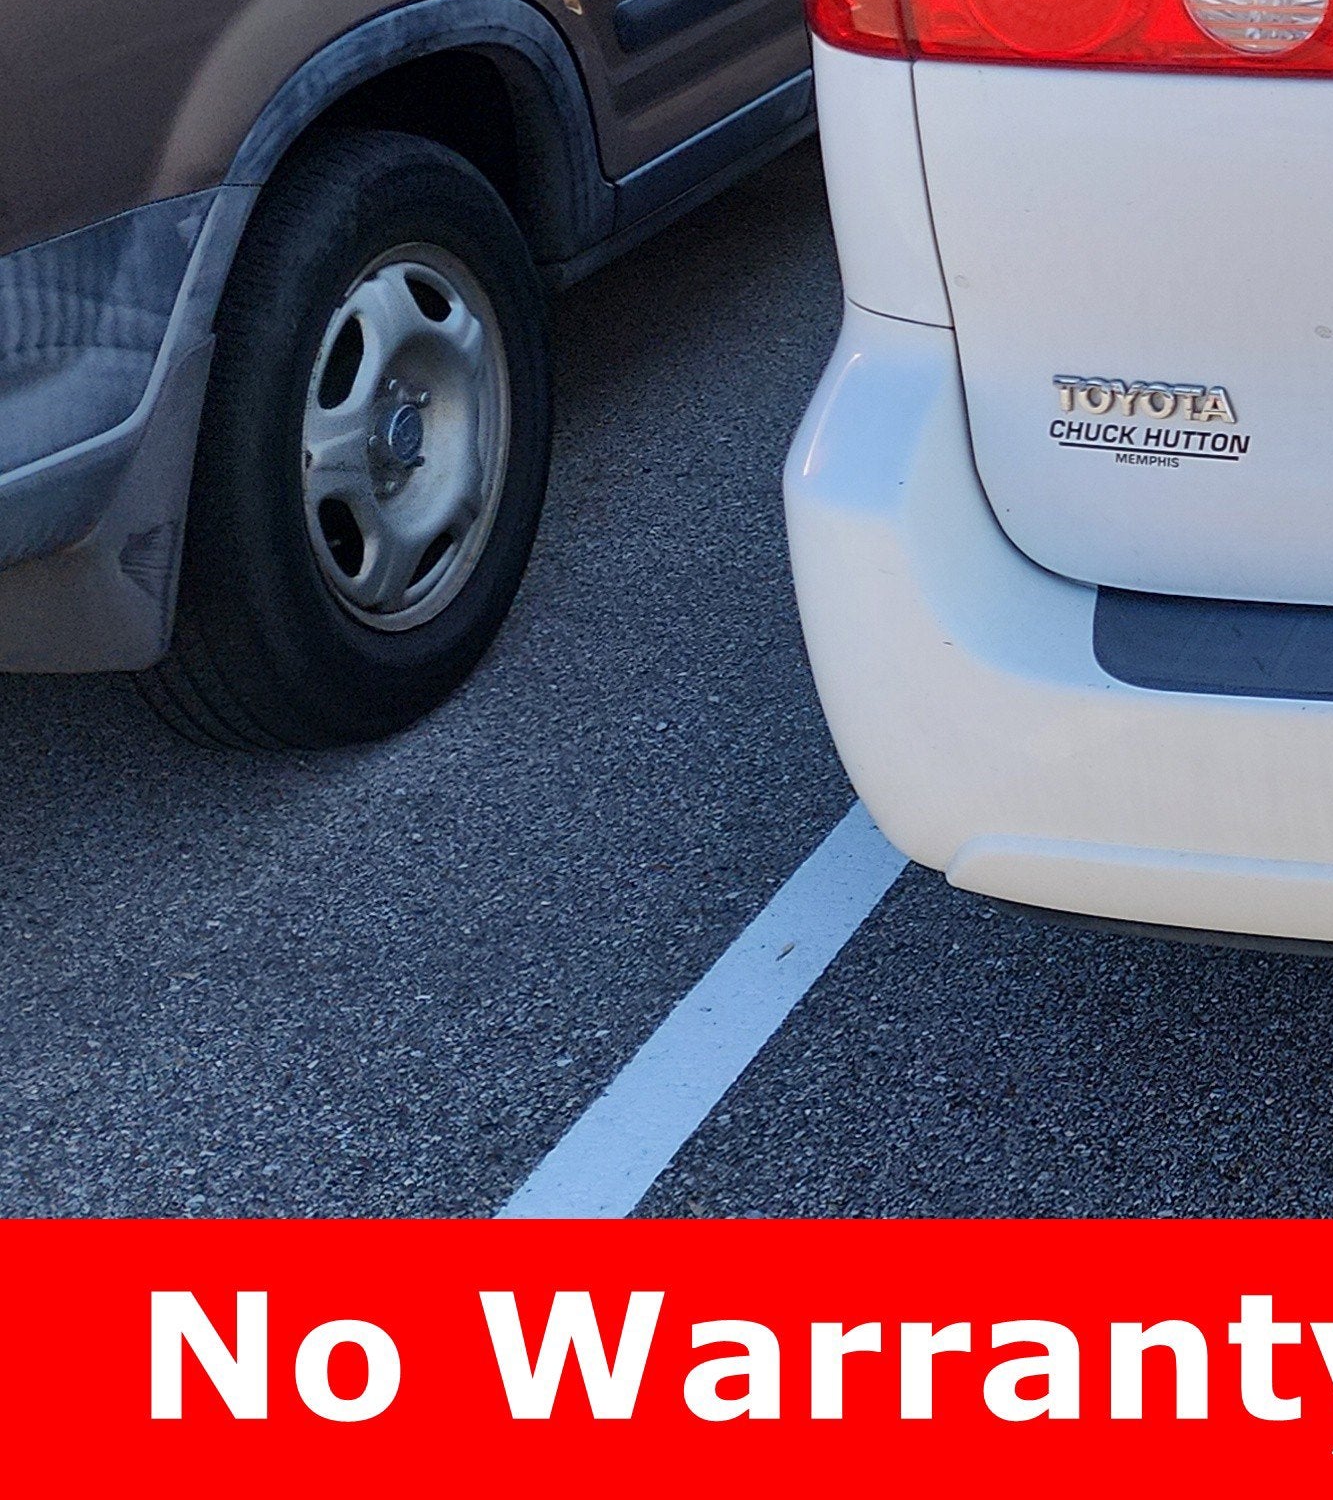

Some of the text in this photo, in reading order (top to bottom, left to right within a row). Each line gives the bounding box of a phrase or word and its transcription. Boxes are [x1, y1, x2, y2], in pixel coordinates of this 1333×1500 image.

[1052, 374, 1237, 424] TOYOTA
[1049, 418, 1251, 454] CHUCK HUTTON
[1115, 452, 1180, 469] MEMPHIS
